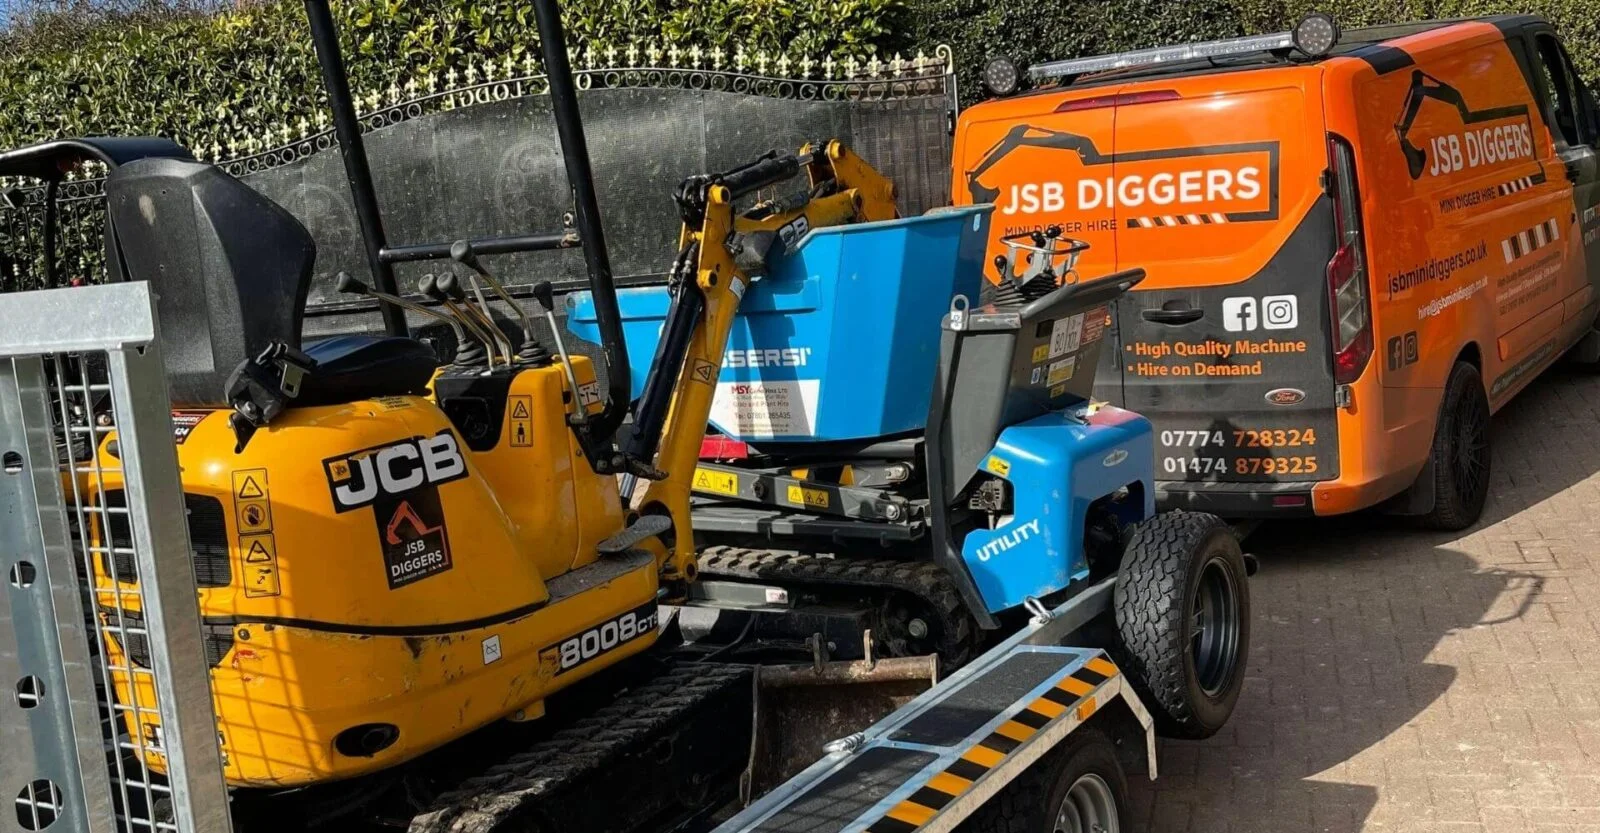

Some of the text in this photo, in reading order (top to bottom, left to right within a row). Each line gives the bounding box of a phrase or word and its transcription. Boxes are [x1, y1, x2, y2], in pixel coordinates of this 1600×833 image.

[1430, 123, 1533, 176] JSB DIGGERS
[1002, 166, 1261, 215] JSB DIGGERS
[1456, 191, 1480, 209] DIGGER
[1087, 219, 1117, 231] HIRE
[1388, 239, 1488, 301] jsbminidiggers.co.uk
[1135, 339, 1306, 358] High Quality Machine
[1137, 361, 1262, 376] Hire on Demand
[1160, 428, 1316, 447] 07774 728324
[335, 433, 465, 506] JCB
[1163, 456, 1318, 474] 01474 879325
[404, 539, 426, 557] JSB
[975, 518, 1041, 562] UTILITY
[391, 550, 443, 577] DIGGERS
